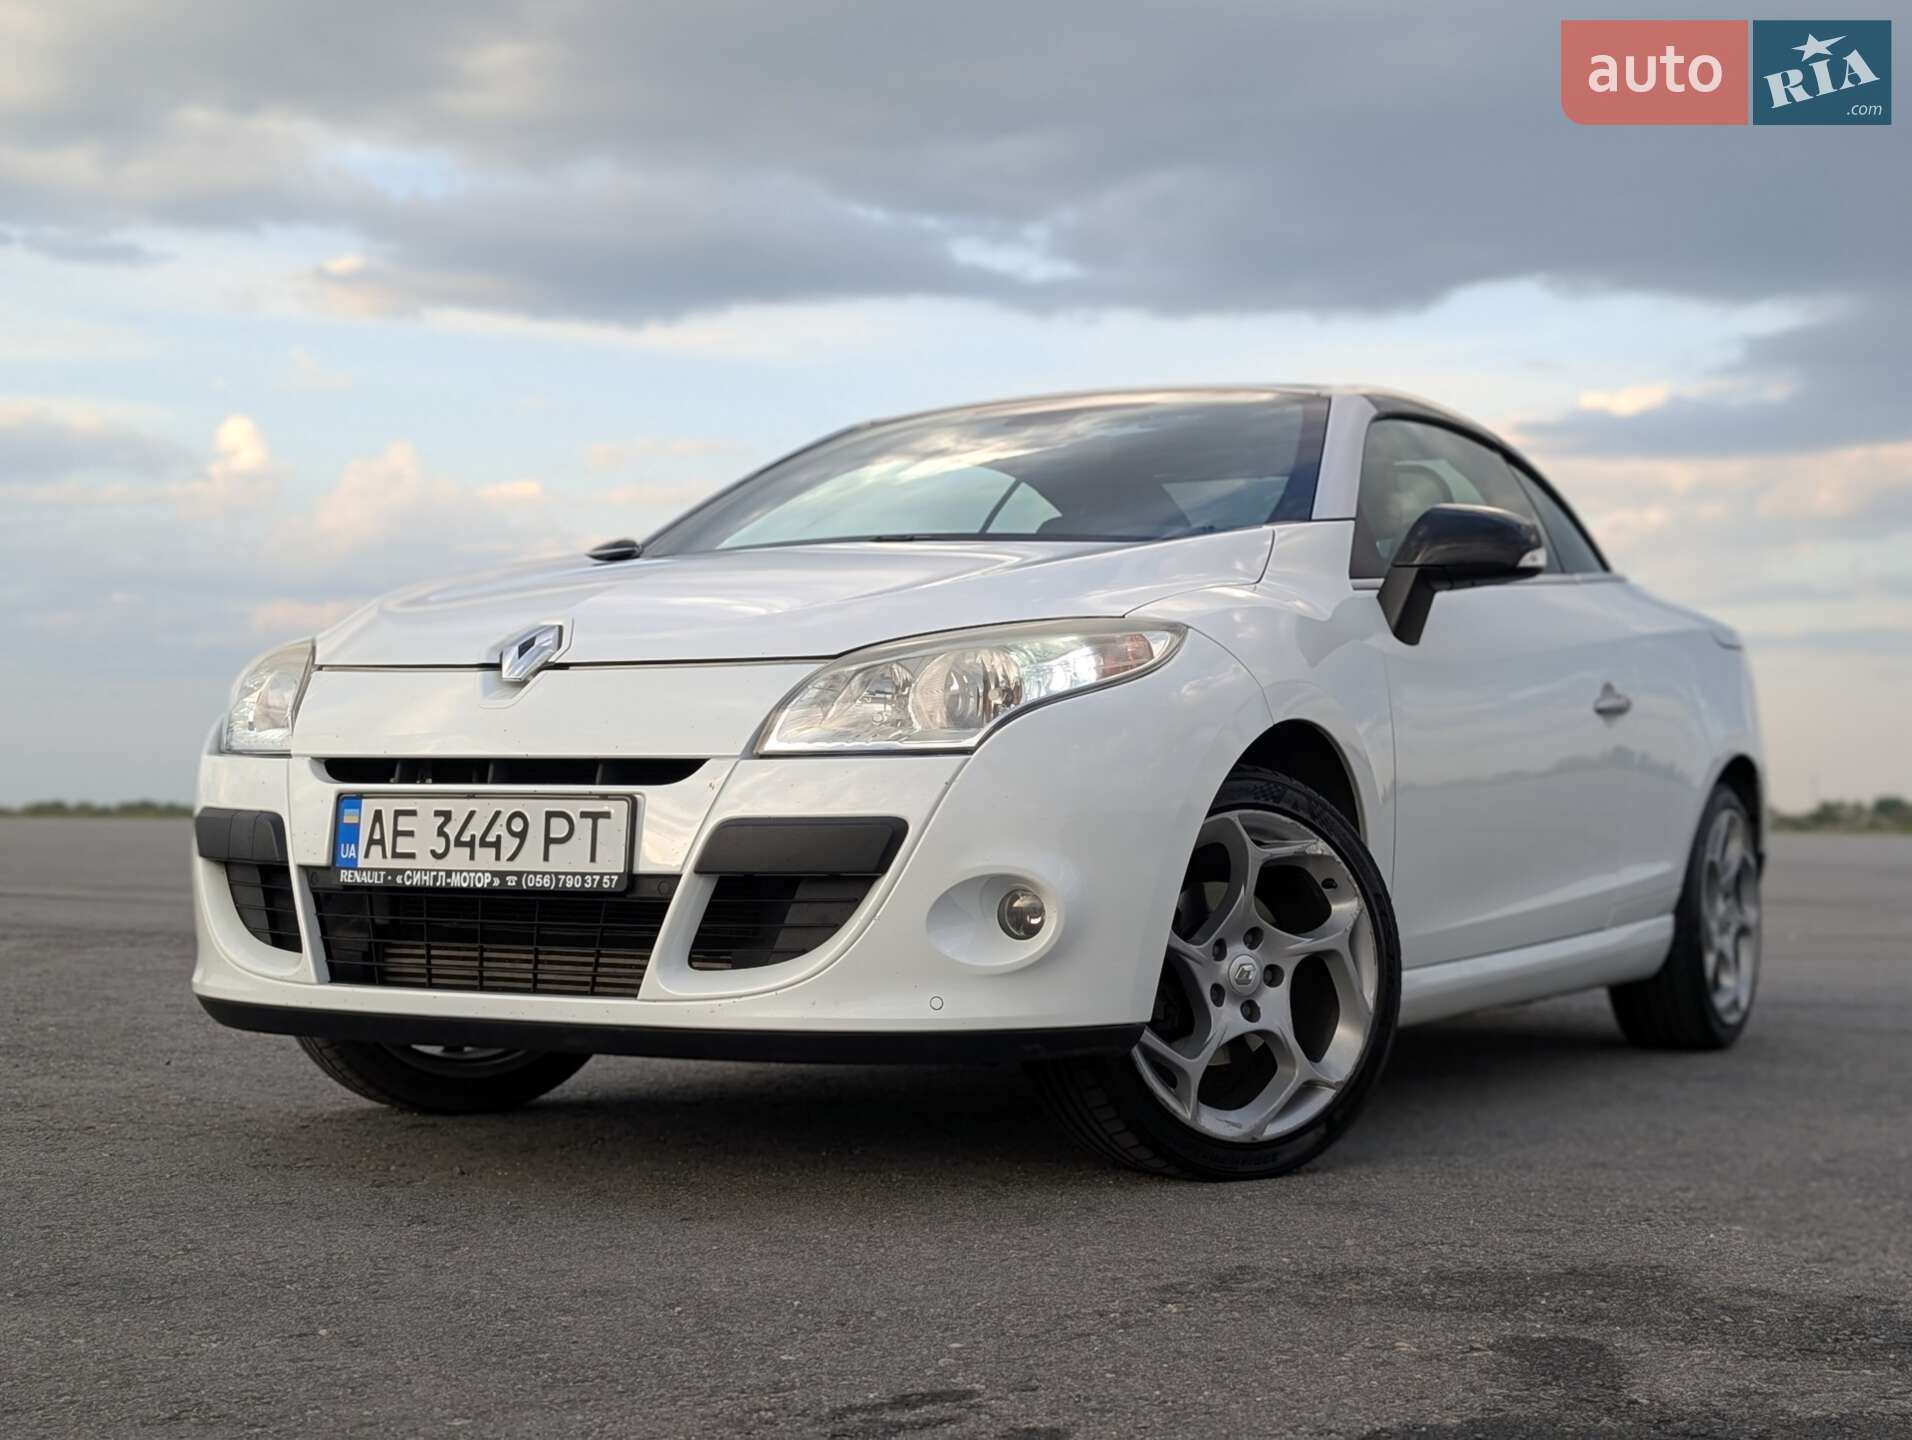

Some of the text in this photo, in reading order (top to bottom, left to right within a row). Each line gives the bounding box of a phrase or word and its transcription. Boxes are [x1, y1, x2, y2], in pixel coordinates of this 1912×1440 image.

[364, 808, 612, 863] AE 3449 PT
[340, 843, 357, 858] UA
[340, 869, 386, 884] RENAULT
[521, 873, 556, 889] (056)
[558, 875, 582, 888] 790
[584, 875, 600, 888] 37
[602, 875, 618, 888] 57
